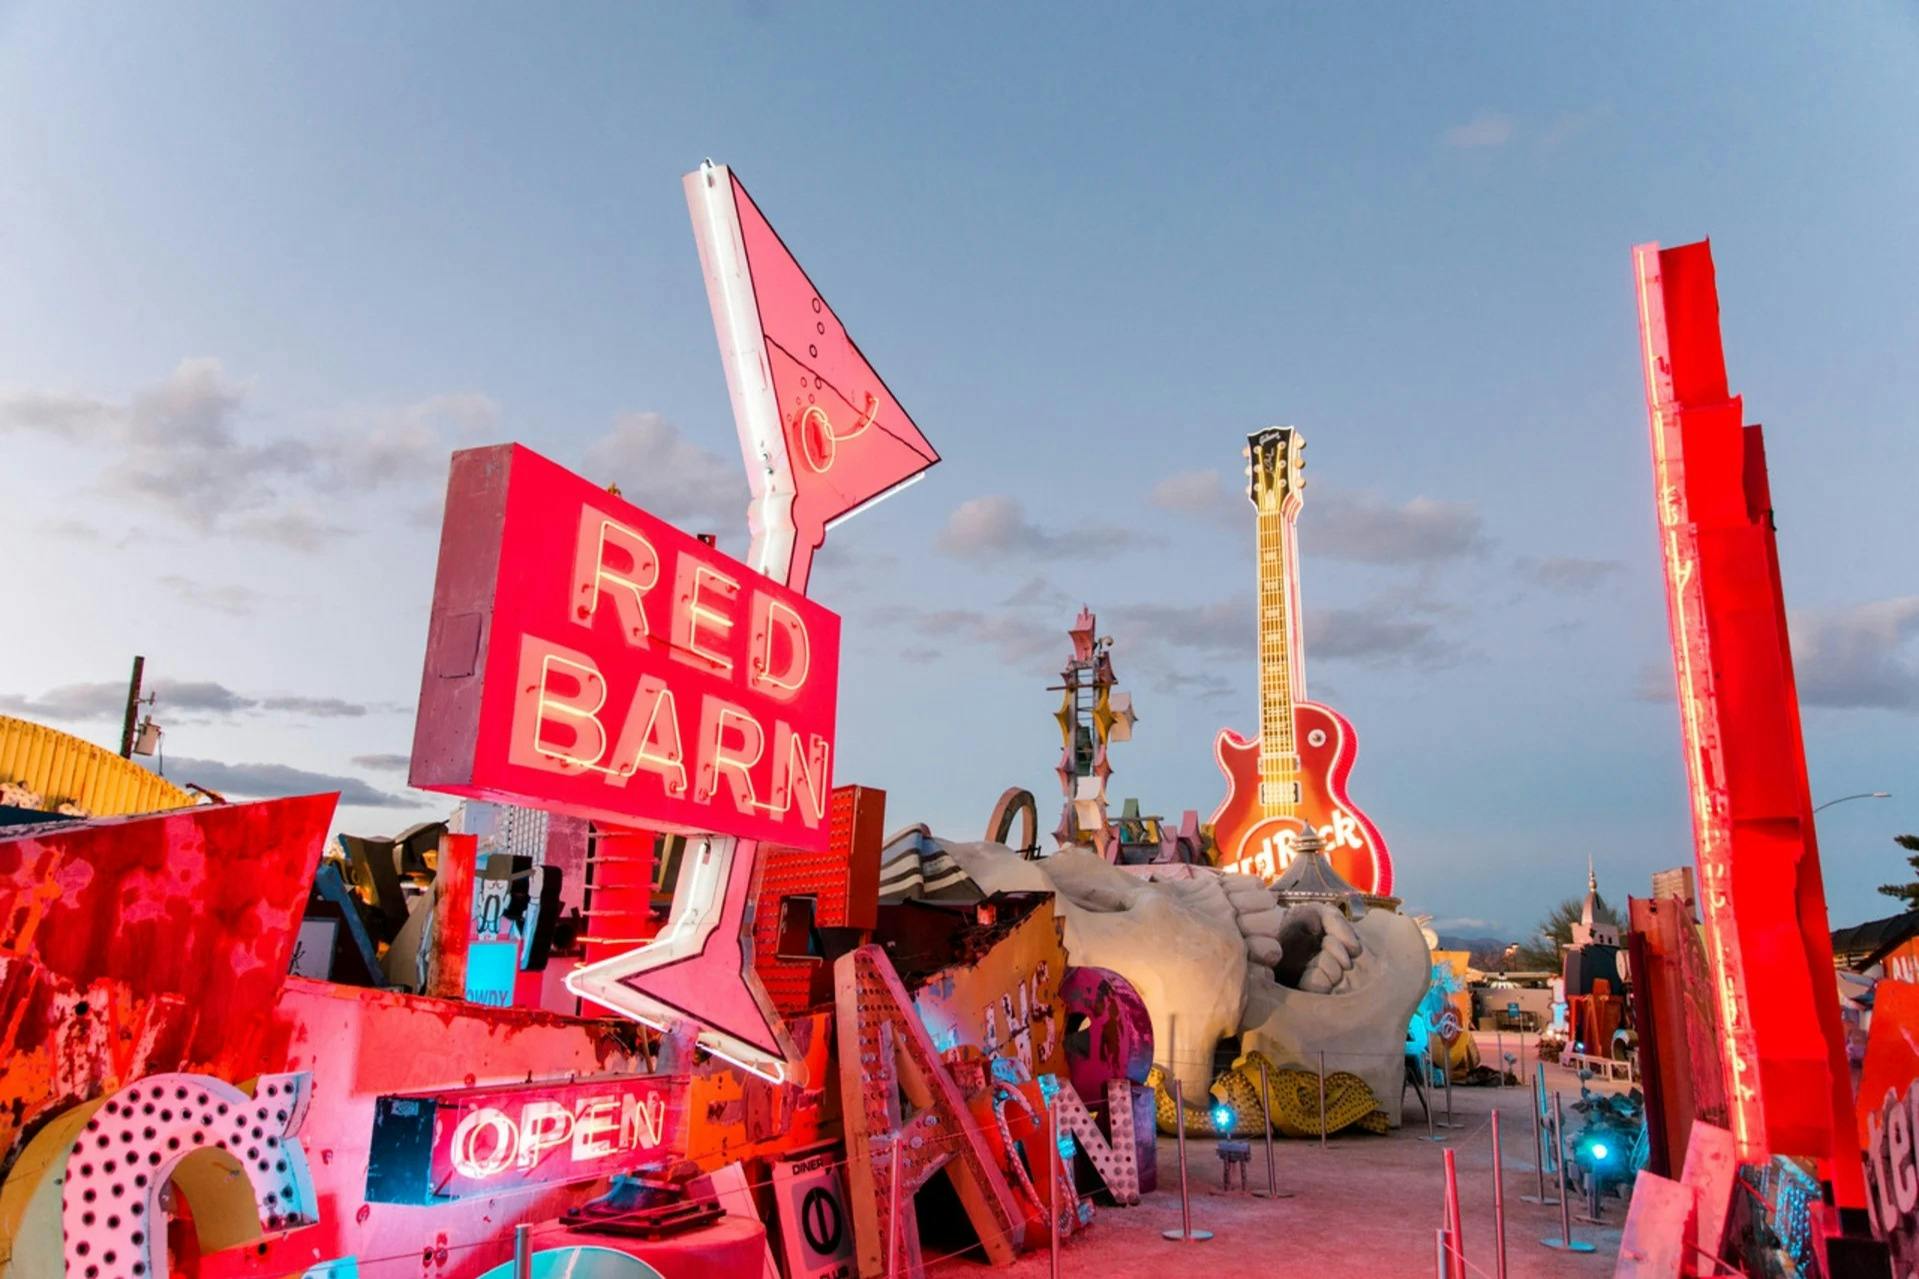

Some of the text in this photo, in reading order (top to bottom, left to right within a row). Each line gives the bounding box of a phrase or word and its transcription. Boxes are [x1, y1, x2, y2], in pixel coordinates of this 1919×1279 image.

[568, 502, 812, 704] RED
[508, 632, 829, 831] BARN
[450, 1089, 666, 1180] OPEN
[792, 1159, 824, 1177] DINER
